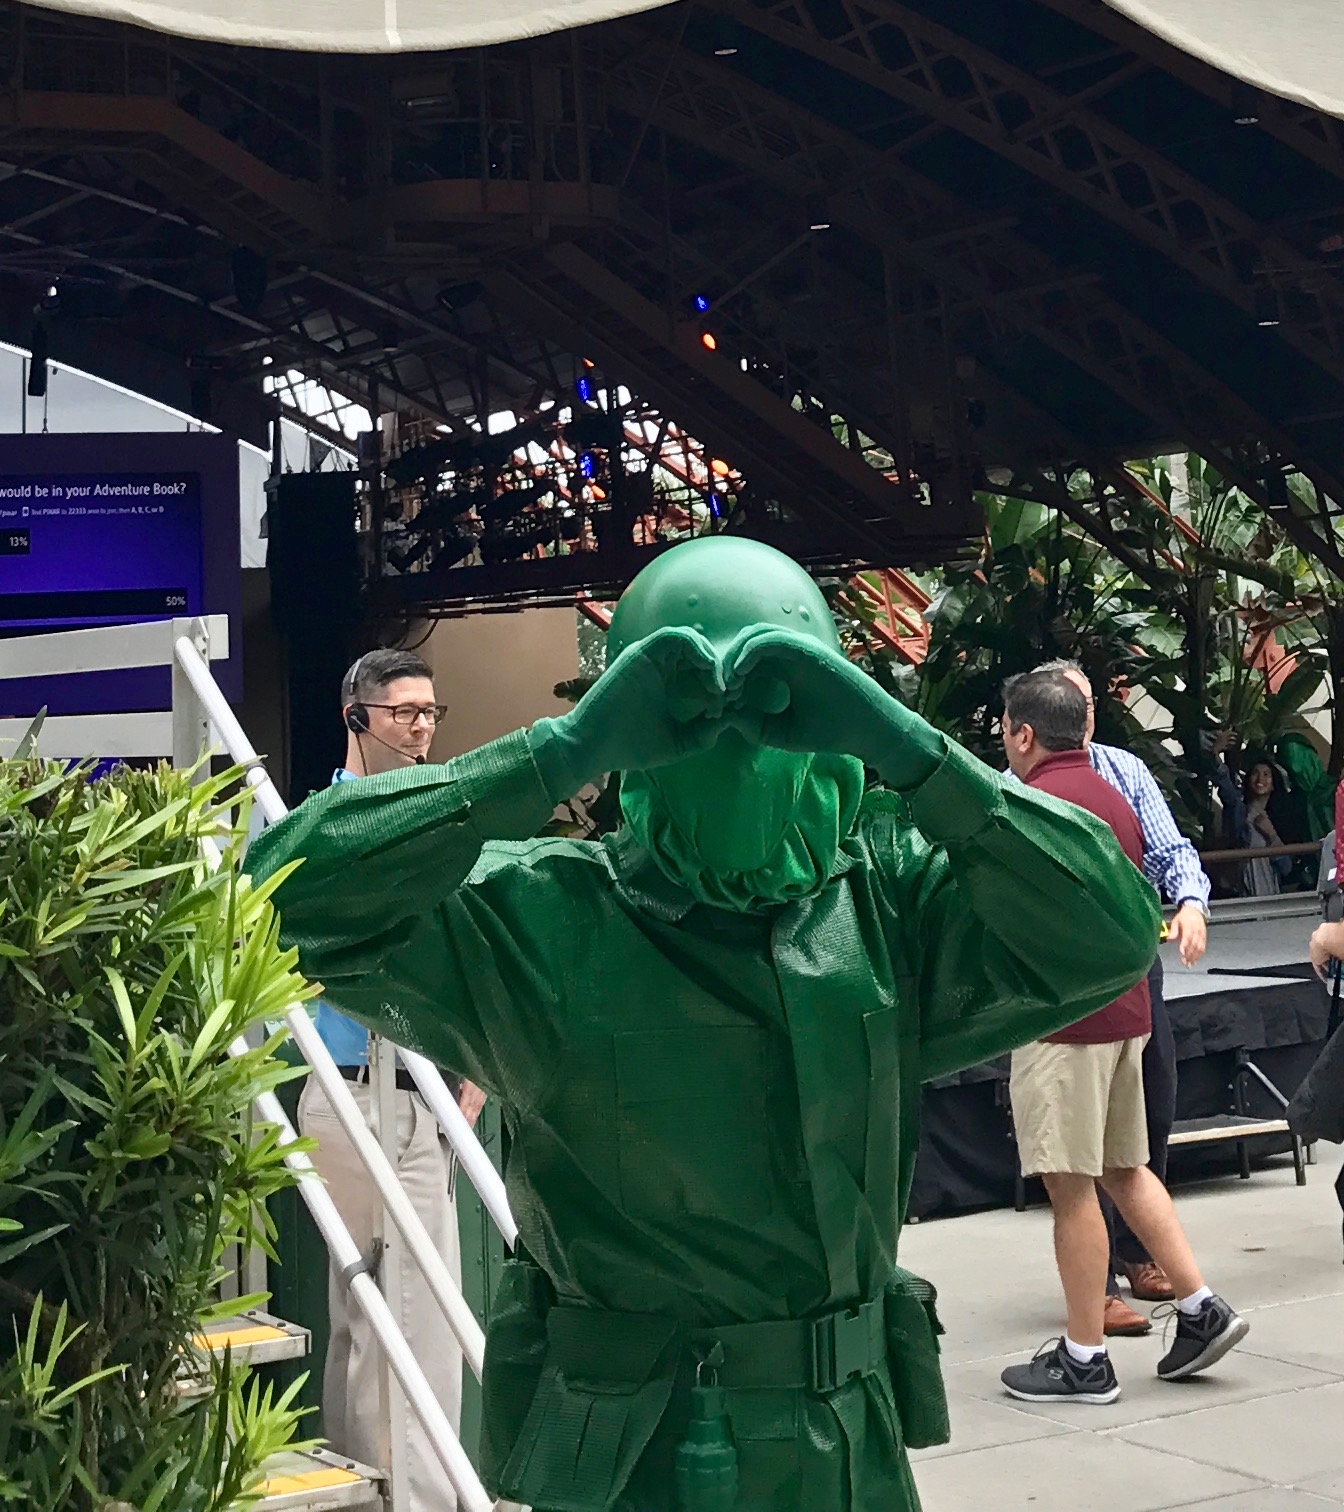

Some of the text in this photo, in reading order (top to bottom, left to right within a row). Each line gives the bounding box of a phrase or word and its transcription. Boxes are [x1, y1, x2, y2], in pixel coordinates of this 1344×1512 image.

[34, 485, 49, 497] be
[52, 485, 63, 497] in
[65, 486, 91, 499] your
[93, 483, 151, 496] Adventure
[153, 482, 187, 495] Book?
[9, 536, 28, 547] 13%
[166, 595, 186, 606] 50%
